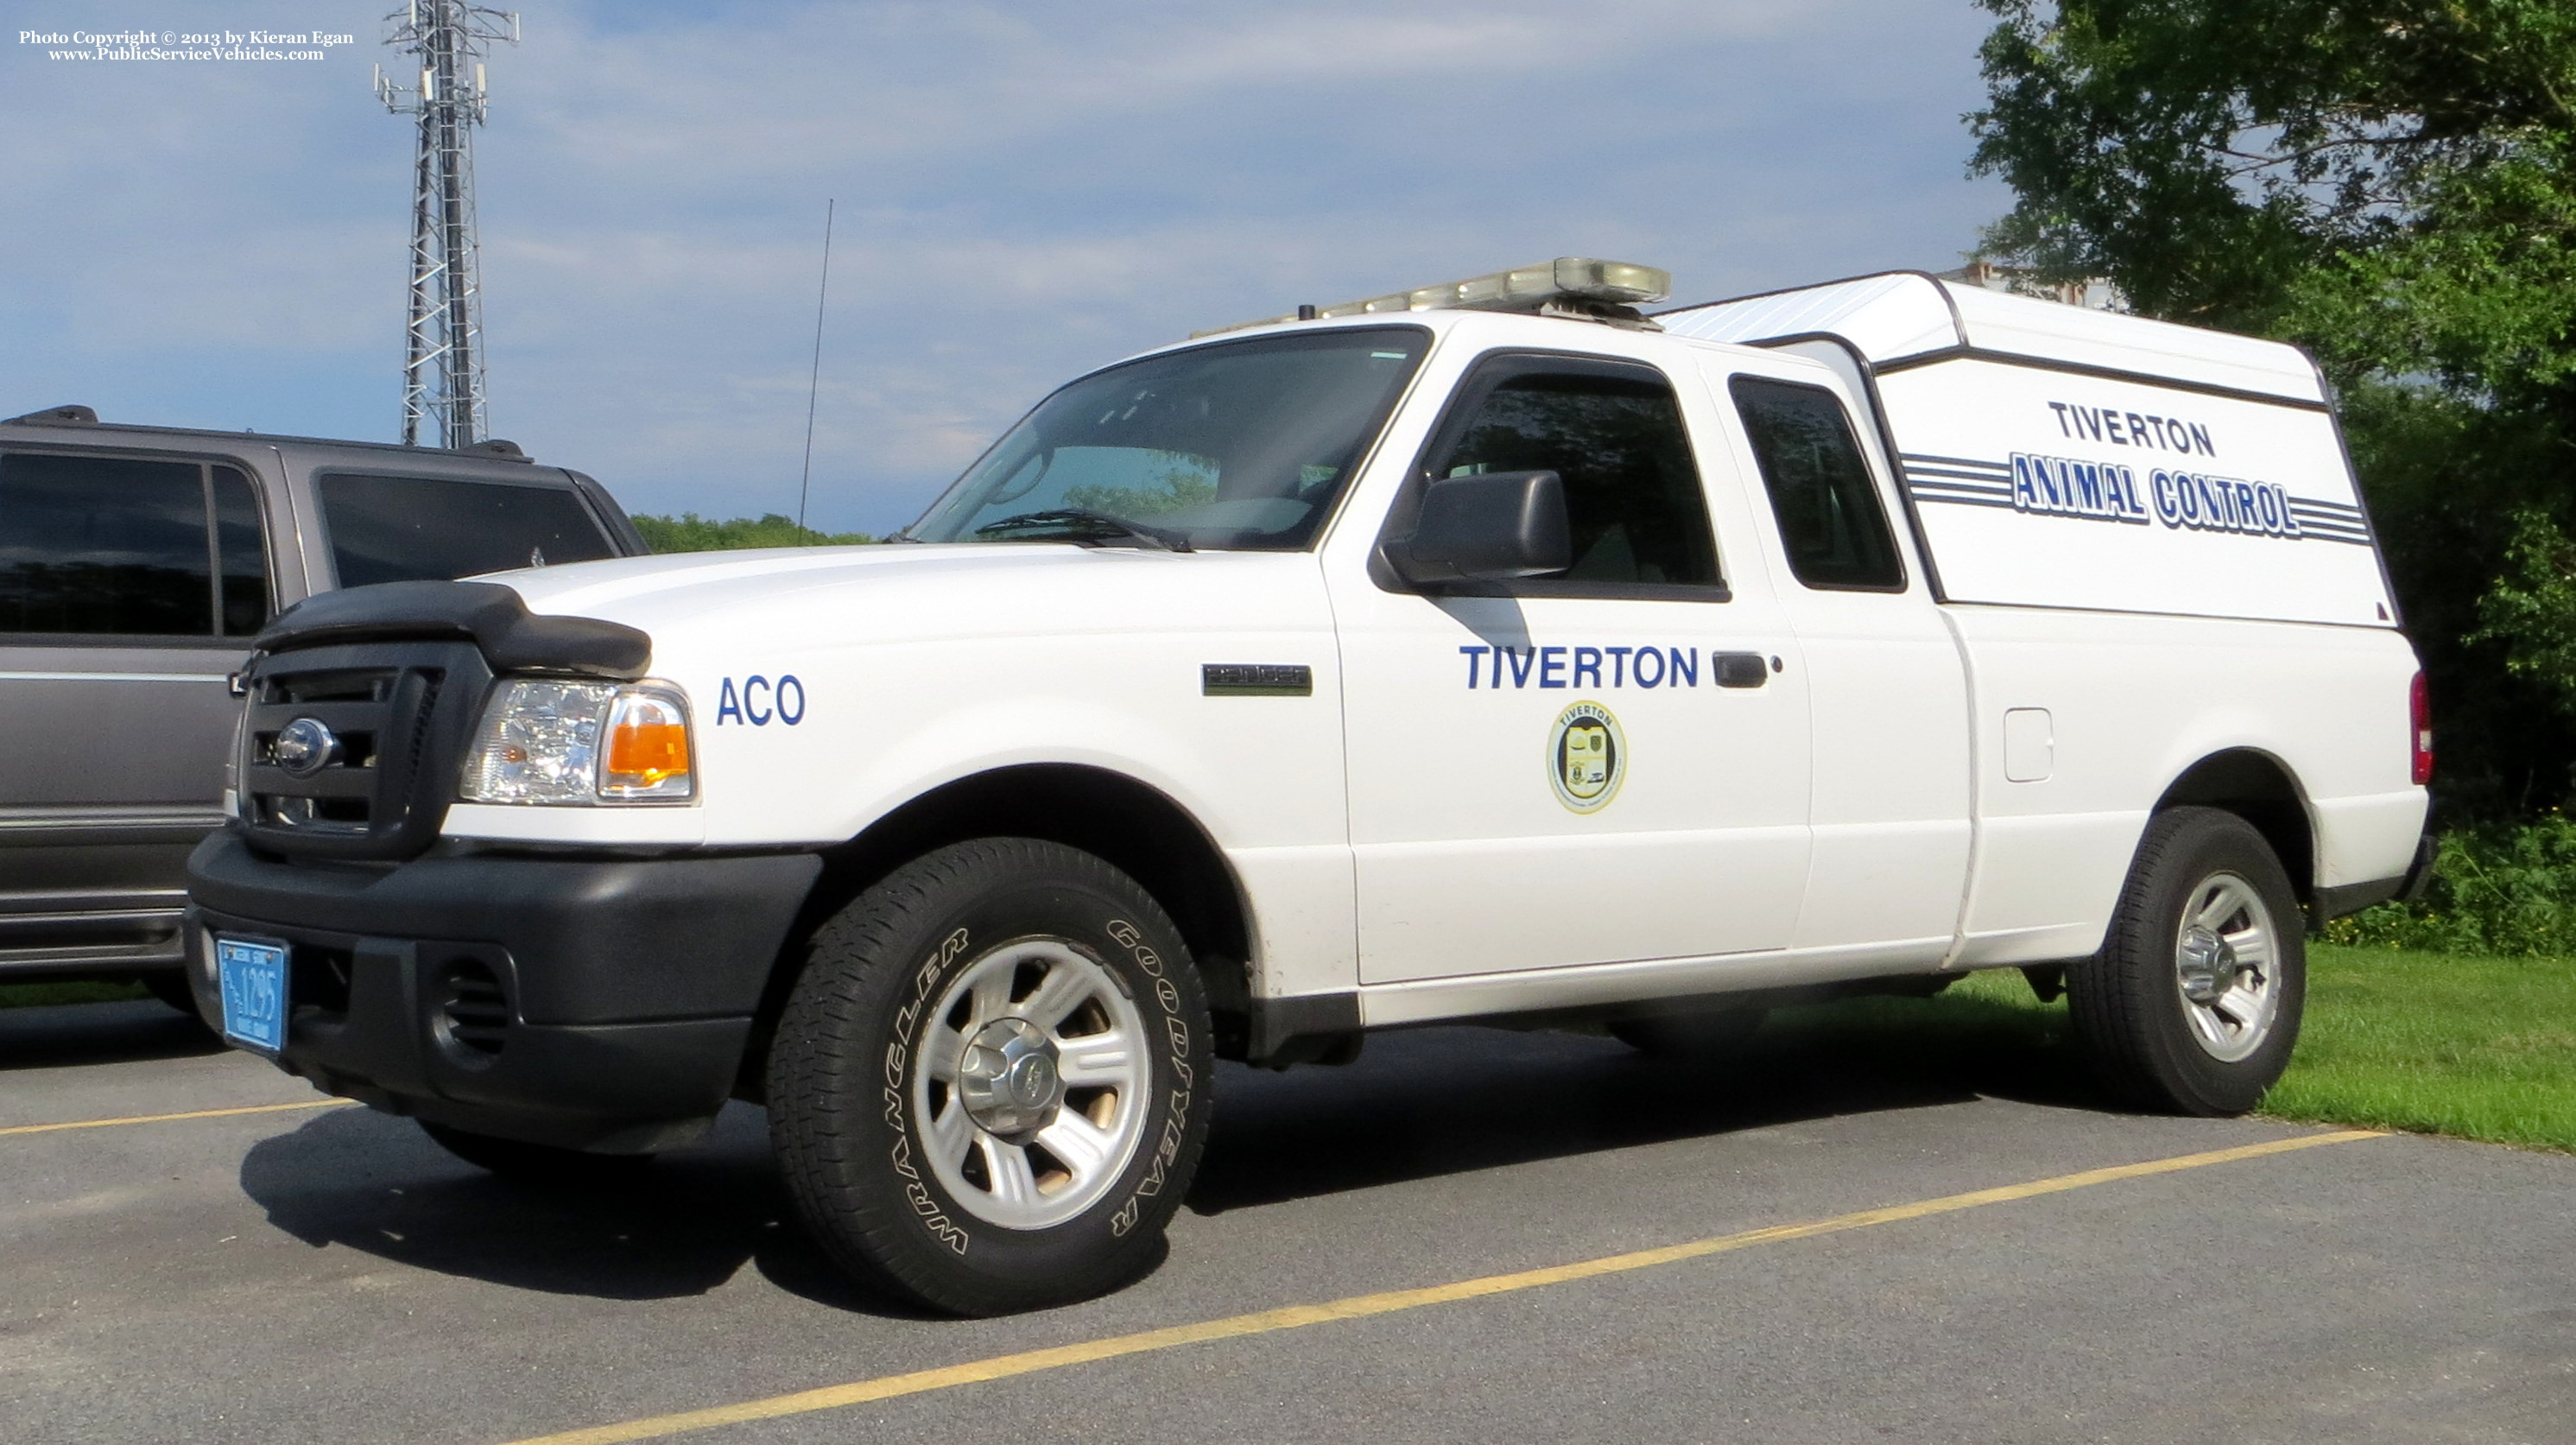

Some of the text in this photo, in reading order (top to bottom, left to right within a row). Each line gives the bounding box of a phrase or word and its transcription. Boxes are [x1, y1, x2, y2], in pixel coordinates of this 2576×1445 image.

[2048, 401, 2217, 458] TIVERTON
[2010, 451, 2303, 539] ANIMAL CONTROL
[1459, 645, 1699, 689] TIVERTON
[717, 674, 806, 726] ACO
[1559, 705, 1614, 727] TIVERTON
[883, 927, 970, 1256] WRANGLER
[1106, 919, 1194, 1238] GOODYEAR
